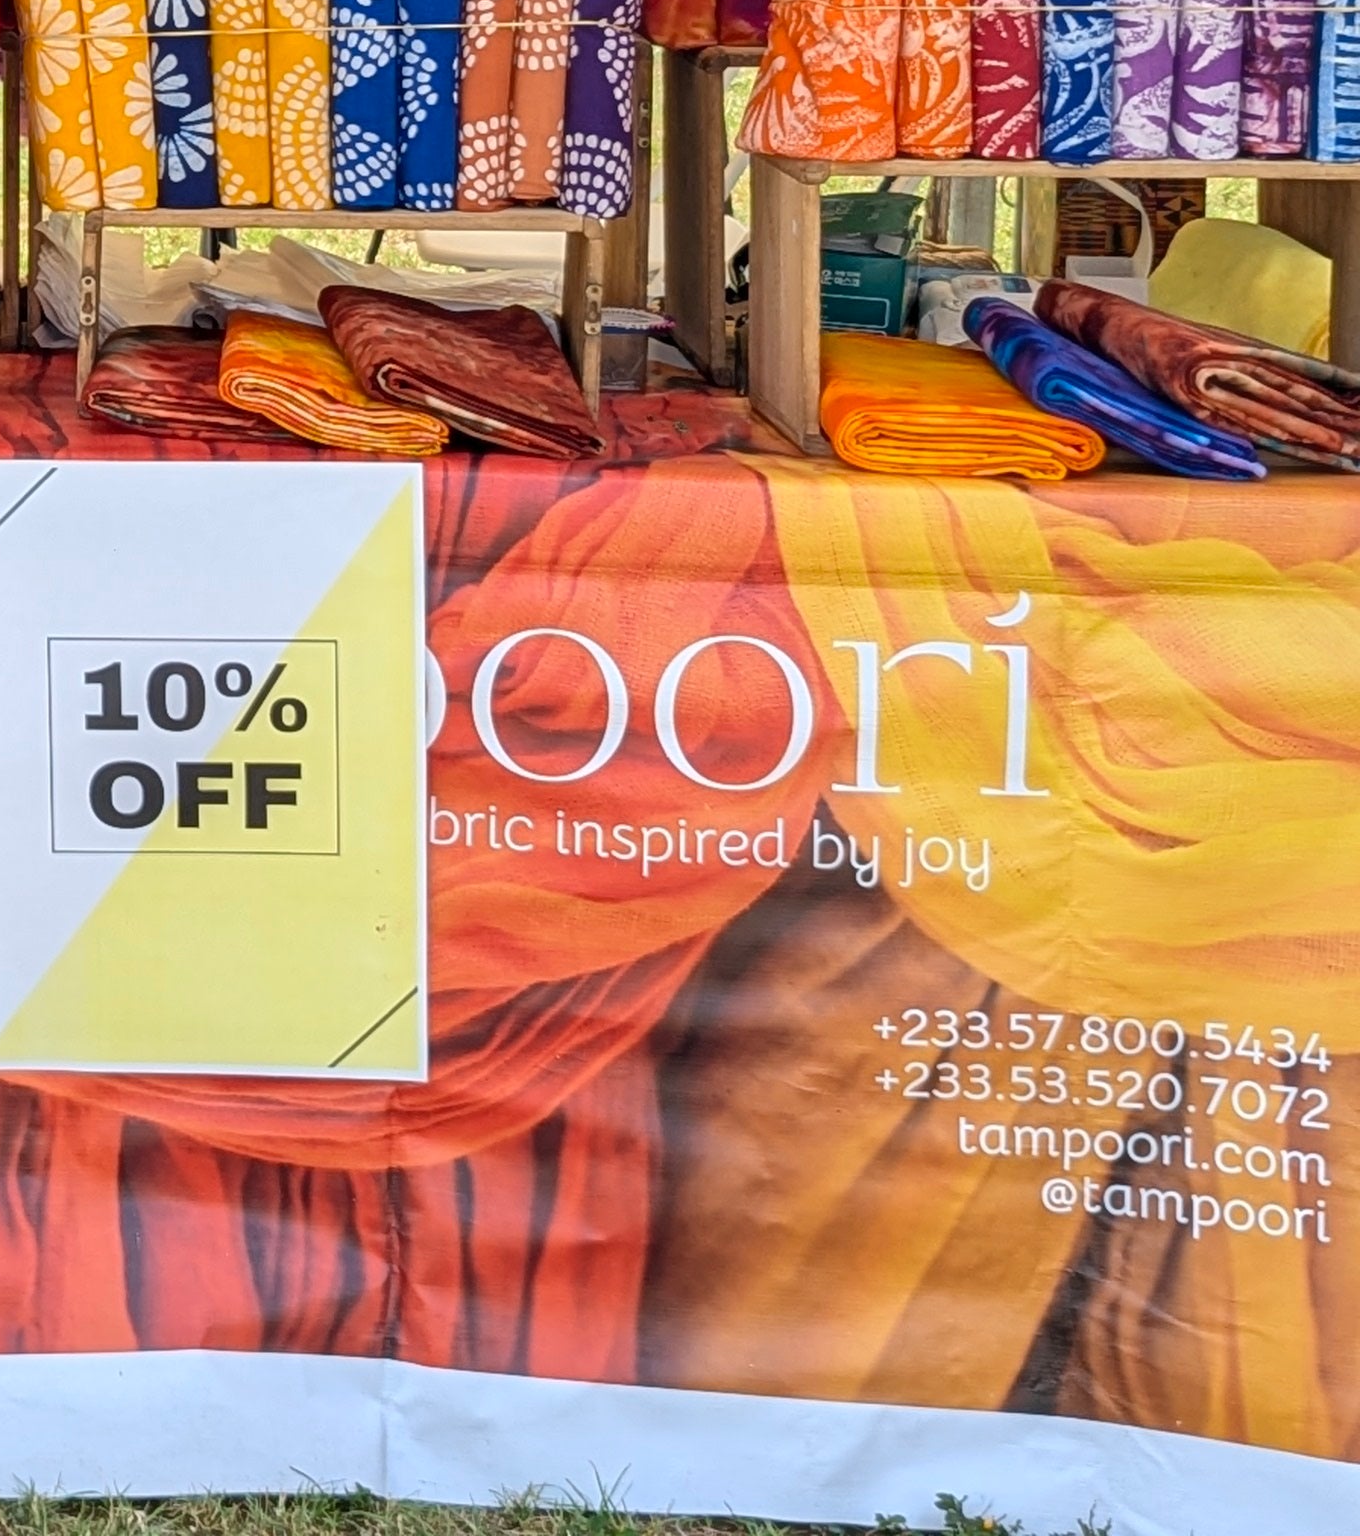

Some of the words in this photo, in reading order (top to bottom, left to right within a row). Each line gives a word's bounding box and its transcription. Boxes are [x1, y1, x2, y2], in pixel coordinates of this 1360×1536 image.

[82, 661, 308, 734] 10%
[89, 760, 302, 829] OFF
[555, 809, 790, 877] inspired
[812, 819, 880, 889] by
[898, 828, 991, 892] joy
[872, 1007, 1332, 1074] +233.57.800.5434
[874, 1060, 1331, 1131] +233.53.520.7072
[957, 1115, 1332, 1187] tampoori.com
[1041, 1175, 1331, 1243] @tampoori
